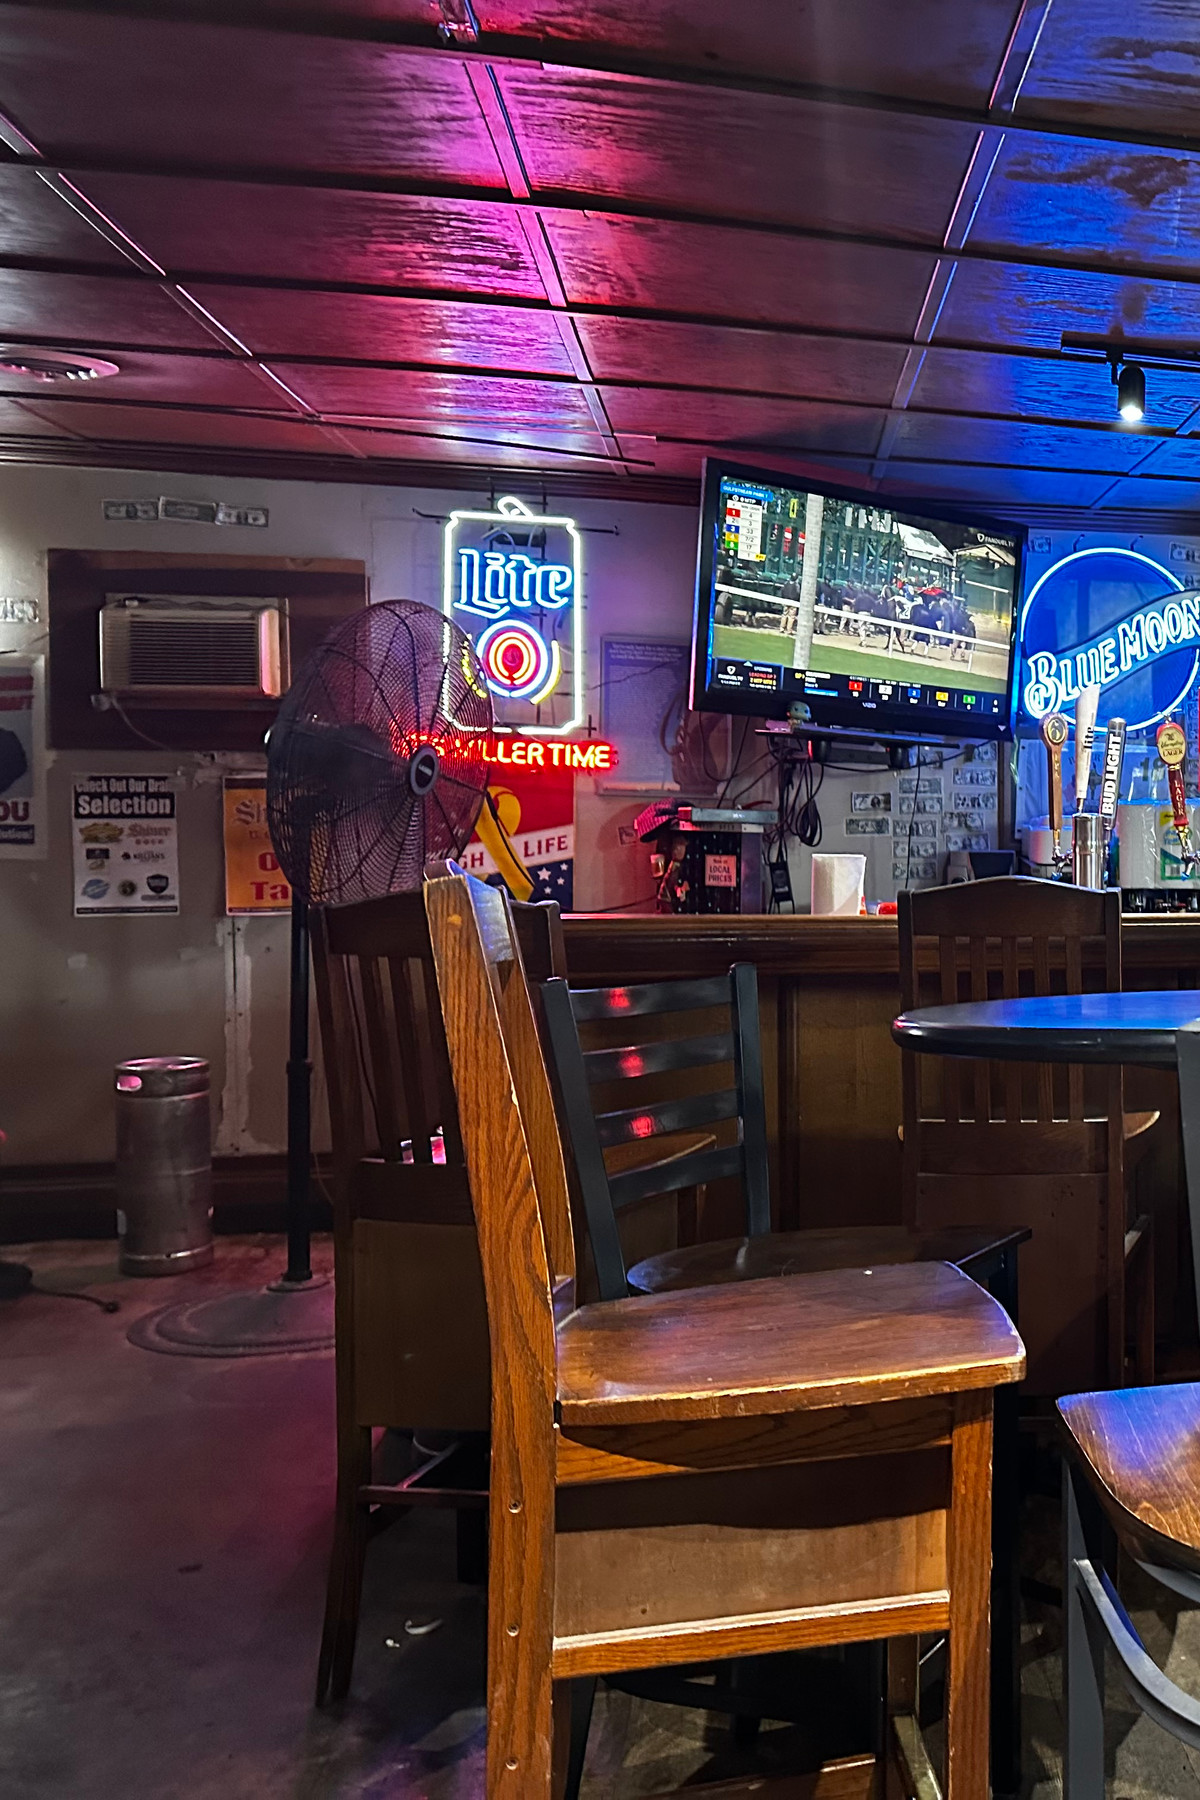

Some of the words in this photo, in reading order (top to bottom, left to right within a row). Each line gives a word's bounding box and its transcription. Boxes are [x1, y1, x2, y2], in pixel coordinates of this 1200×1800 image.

[452, 548, 573, 619] Lite
[1023, 638, 1120, 720] BLUE
[1083, 726, 1095, 750] lite
[546, 743, 612, 768] TIME
[1105, 733, 1122, 781] LIGHT
[109, 778, 127, 793] Out
[128, 778, 147, 793] Our
[1174, 779, 1185, 816] LAGER
[77, 794, 171, 815] Selection
[1101, 780, 1117, 816] BUD
[0, 800, 29, 822] OU
[523, 834, 569, 858] LIFE
[250, 881, 289, 901] Ta
[708, 875, 733, 883] PRICES
